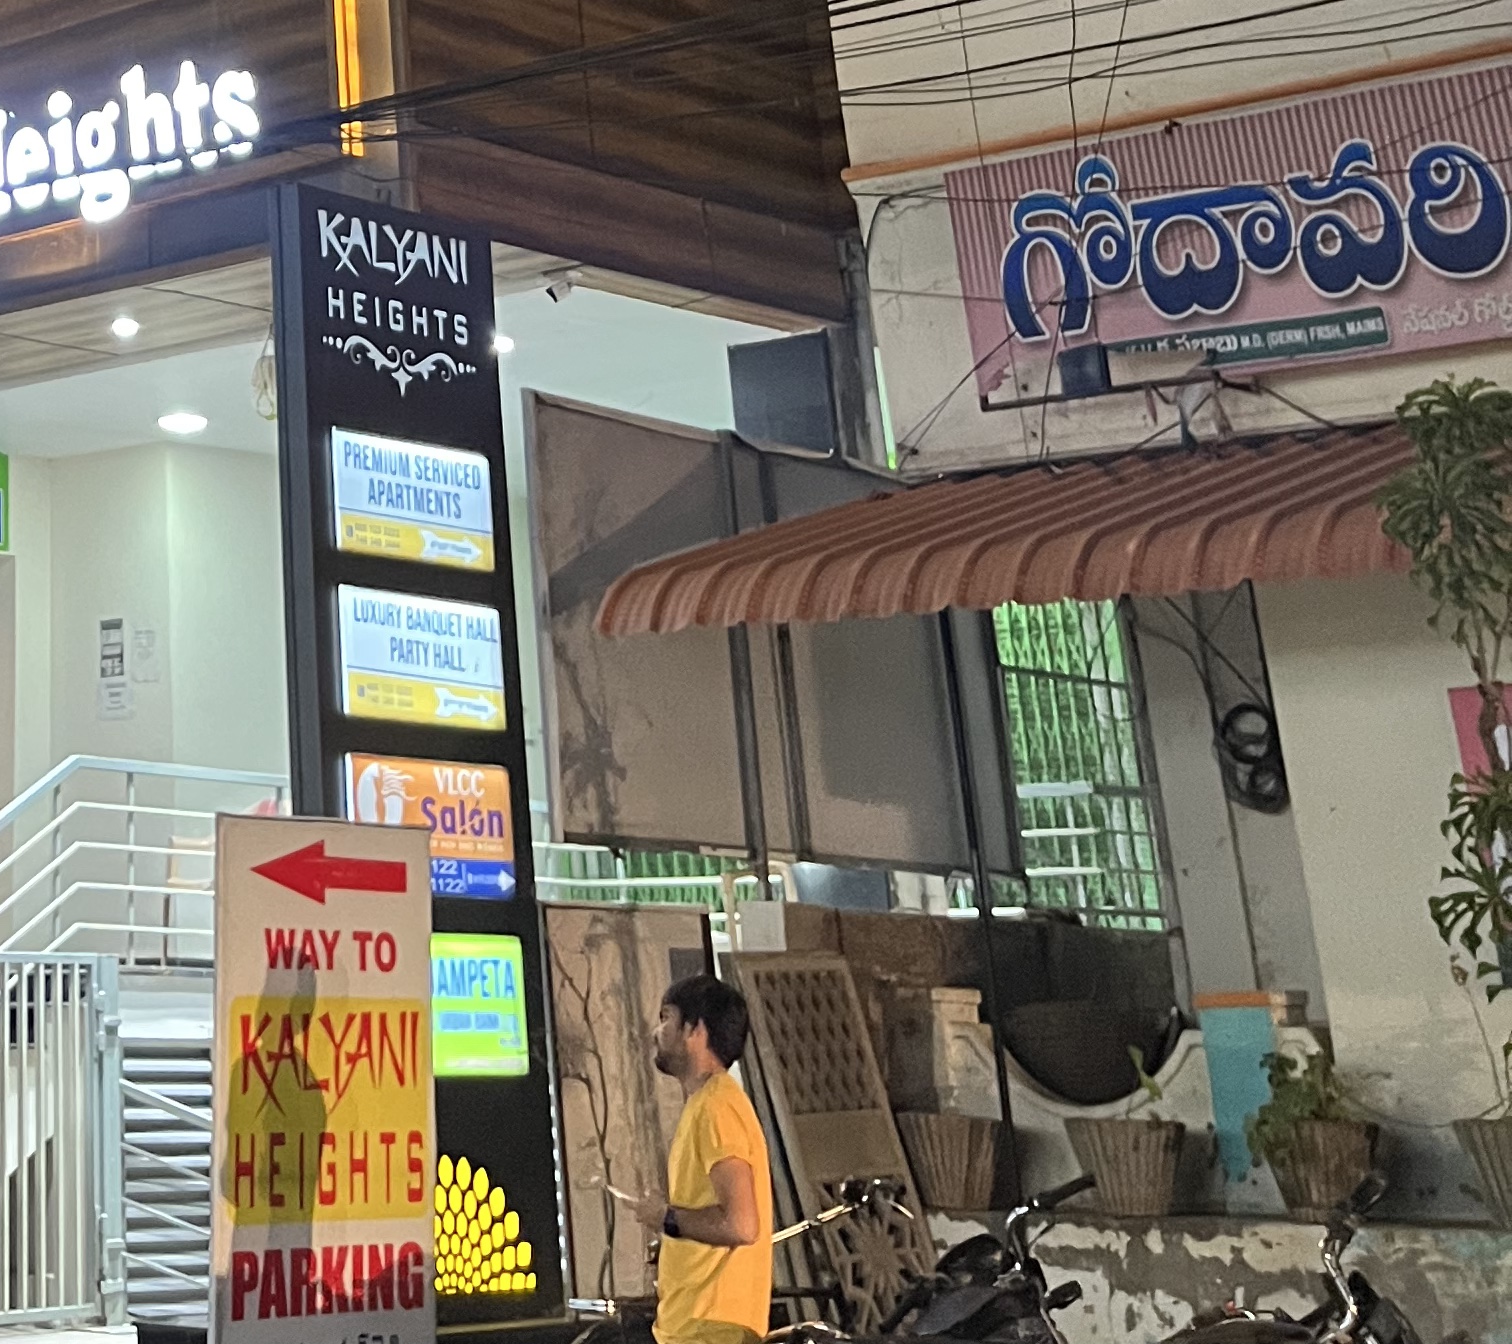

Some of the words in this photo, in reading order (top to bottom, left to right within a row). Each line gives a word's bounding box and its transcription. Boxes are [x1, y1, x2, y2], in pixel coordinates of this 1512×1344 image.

[317, 209, 468, 285] KALYANI
[1000, 138, 1512, 342] గోదావరి
[327, 286, 468, 345] HEIGHTS
[344, 441, 410, 478] PREMIUM
[414, 455, 481, 490] SERVICED
[367, 478, 462, 519] APARTMENTS
[353, 597, 402, 629] LUXURY
[406, 608, 462, 638] BANQUET
[466, 615, 498, 643] HALL
[390, 636, 430, 668] PARTY
[433, 641, 467, 672] HALL
[432, 766, 486, 798] VLCC
[420, 796, 505, 839] Salón
[264, 927, 340, 973] WAY
[352, 929, 397, 974] TO
[431, 958, 518, 999] AMPETA
[239, 1010, 420, 1116] KALYANI
[233, 1129, 425, 1211] HEIGHTS
[230, 1240, 425, 1322] PARKING
